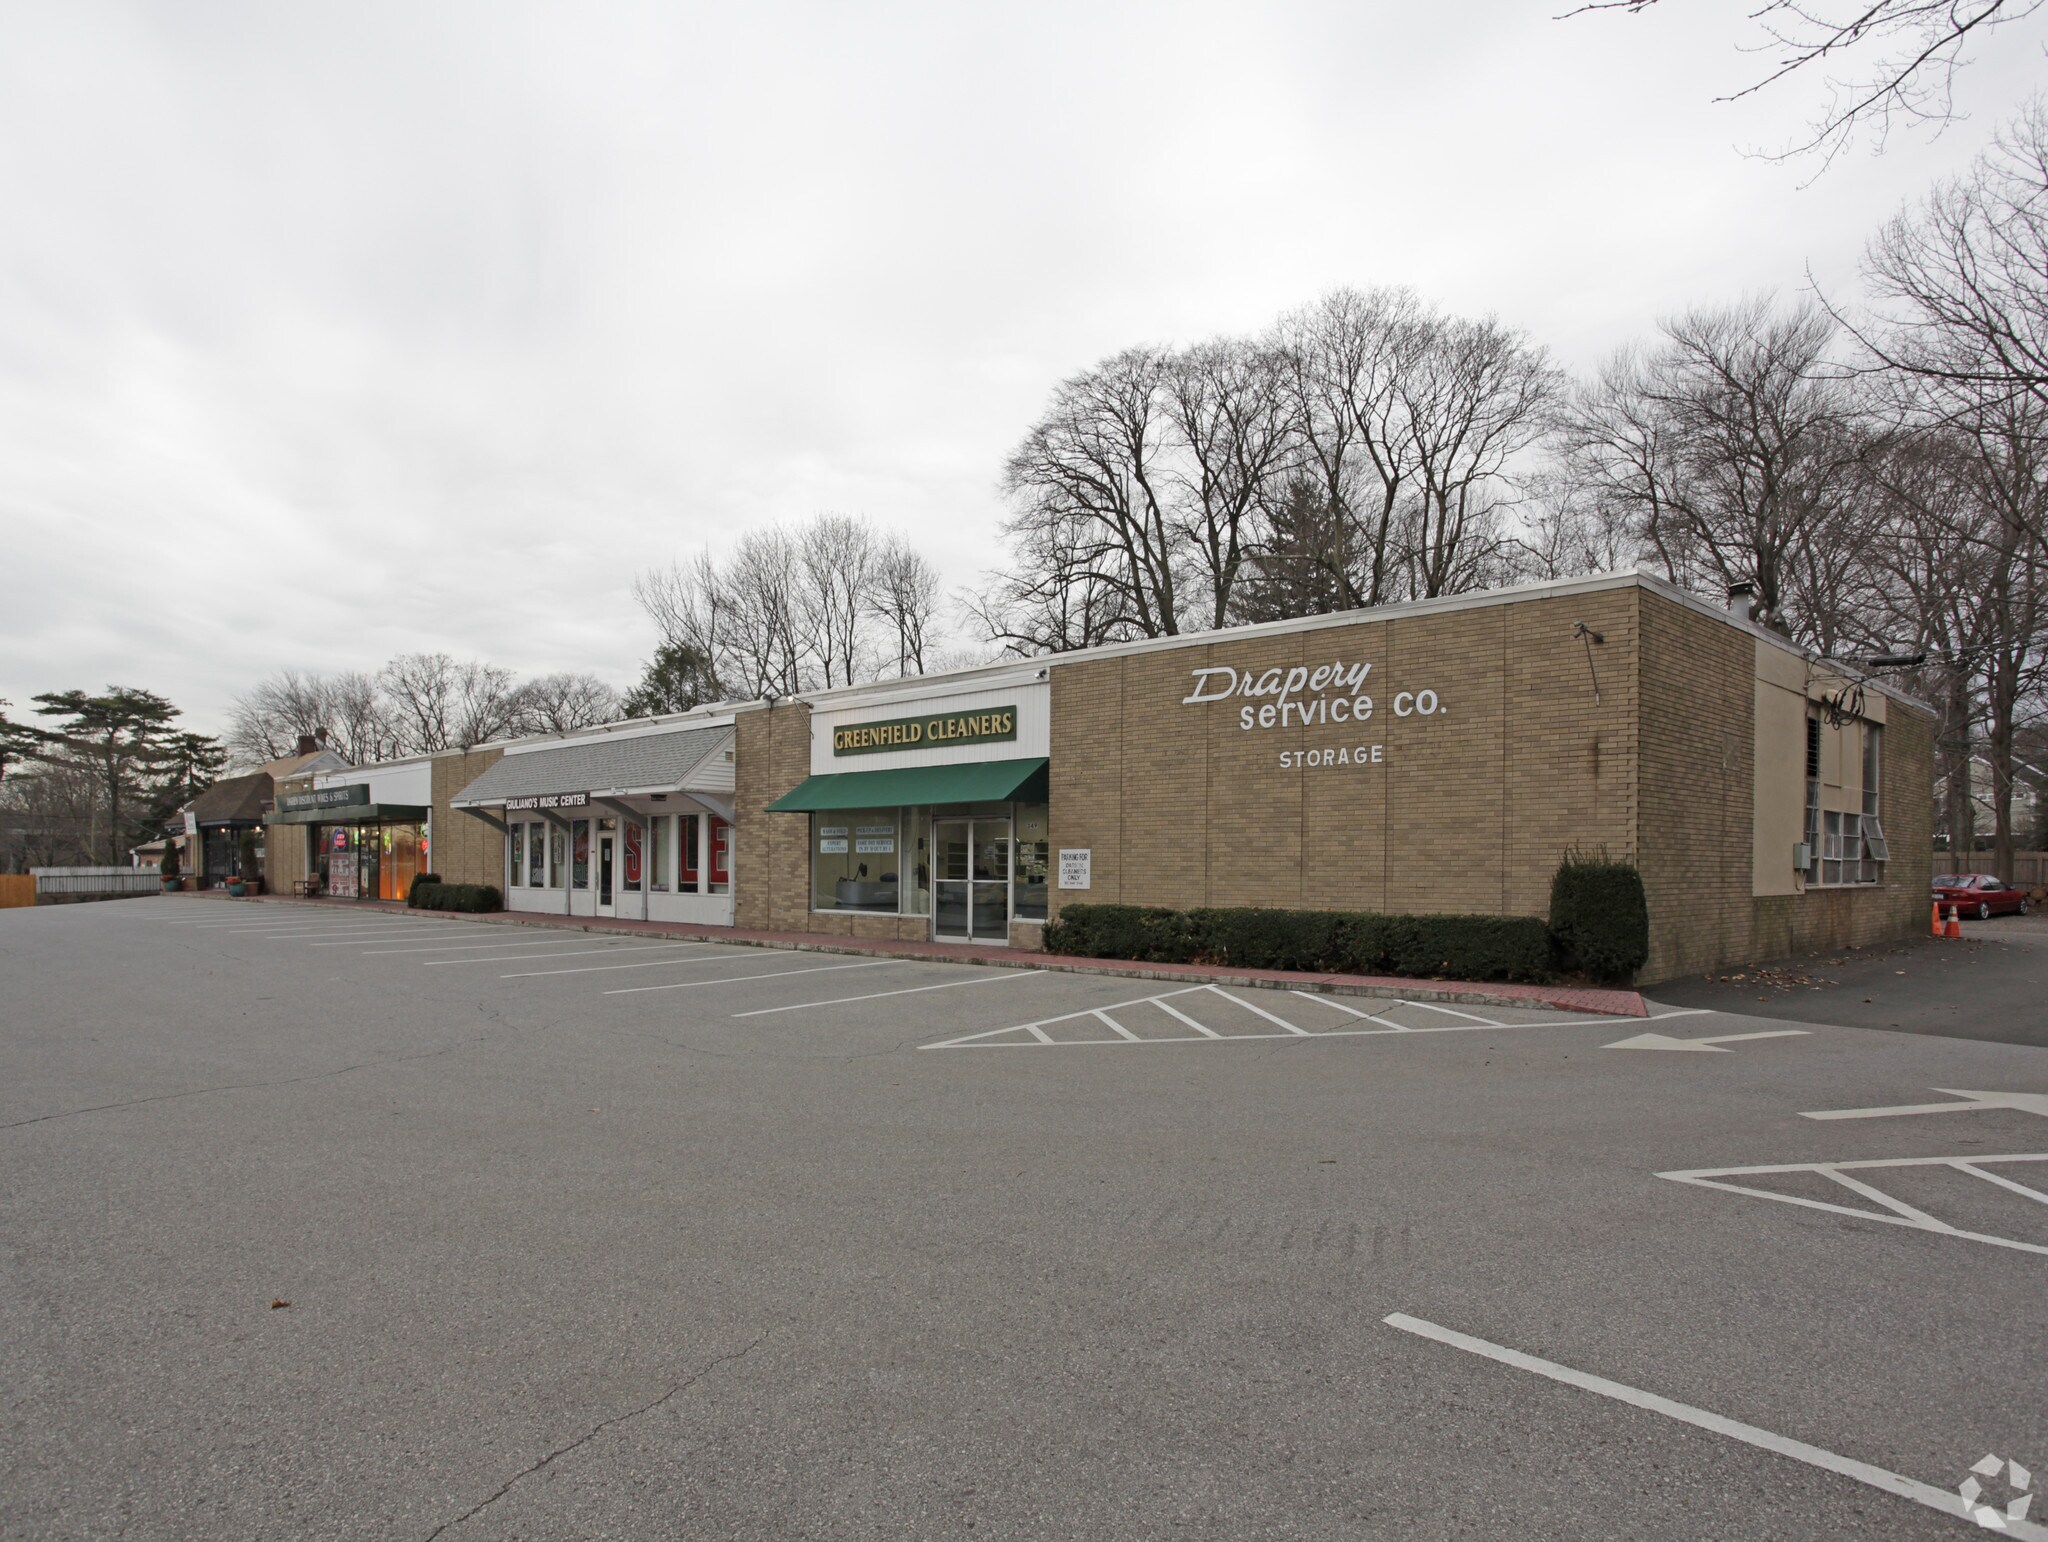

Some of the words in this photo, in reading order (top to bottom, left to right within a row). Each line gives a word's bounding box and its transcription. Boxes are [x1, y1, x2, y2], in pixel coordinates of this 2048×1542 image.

[1182, 660, 1373, 709] Drapery
[833, 722, 922, 751] GREENFIELD
[927, 712, 1013, 741] CLEANERS
[1279, 745, 1383, 768] STORAGE
[506, 797, 538, 810] GIULIANO'S
[539, 795, 559, 808] MUSIC
[560, 793, 586, 807] CENTER
[1061, 853, 1078, 861] PARKING
[1079, 853, 1088, 861] FOR
